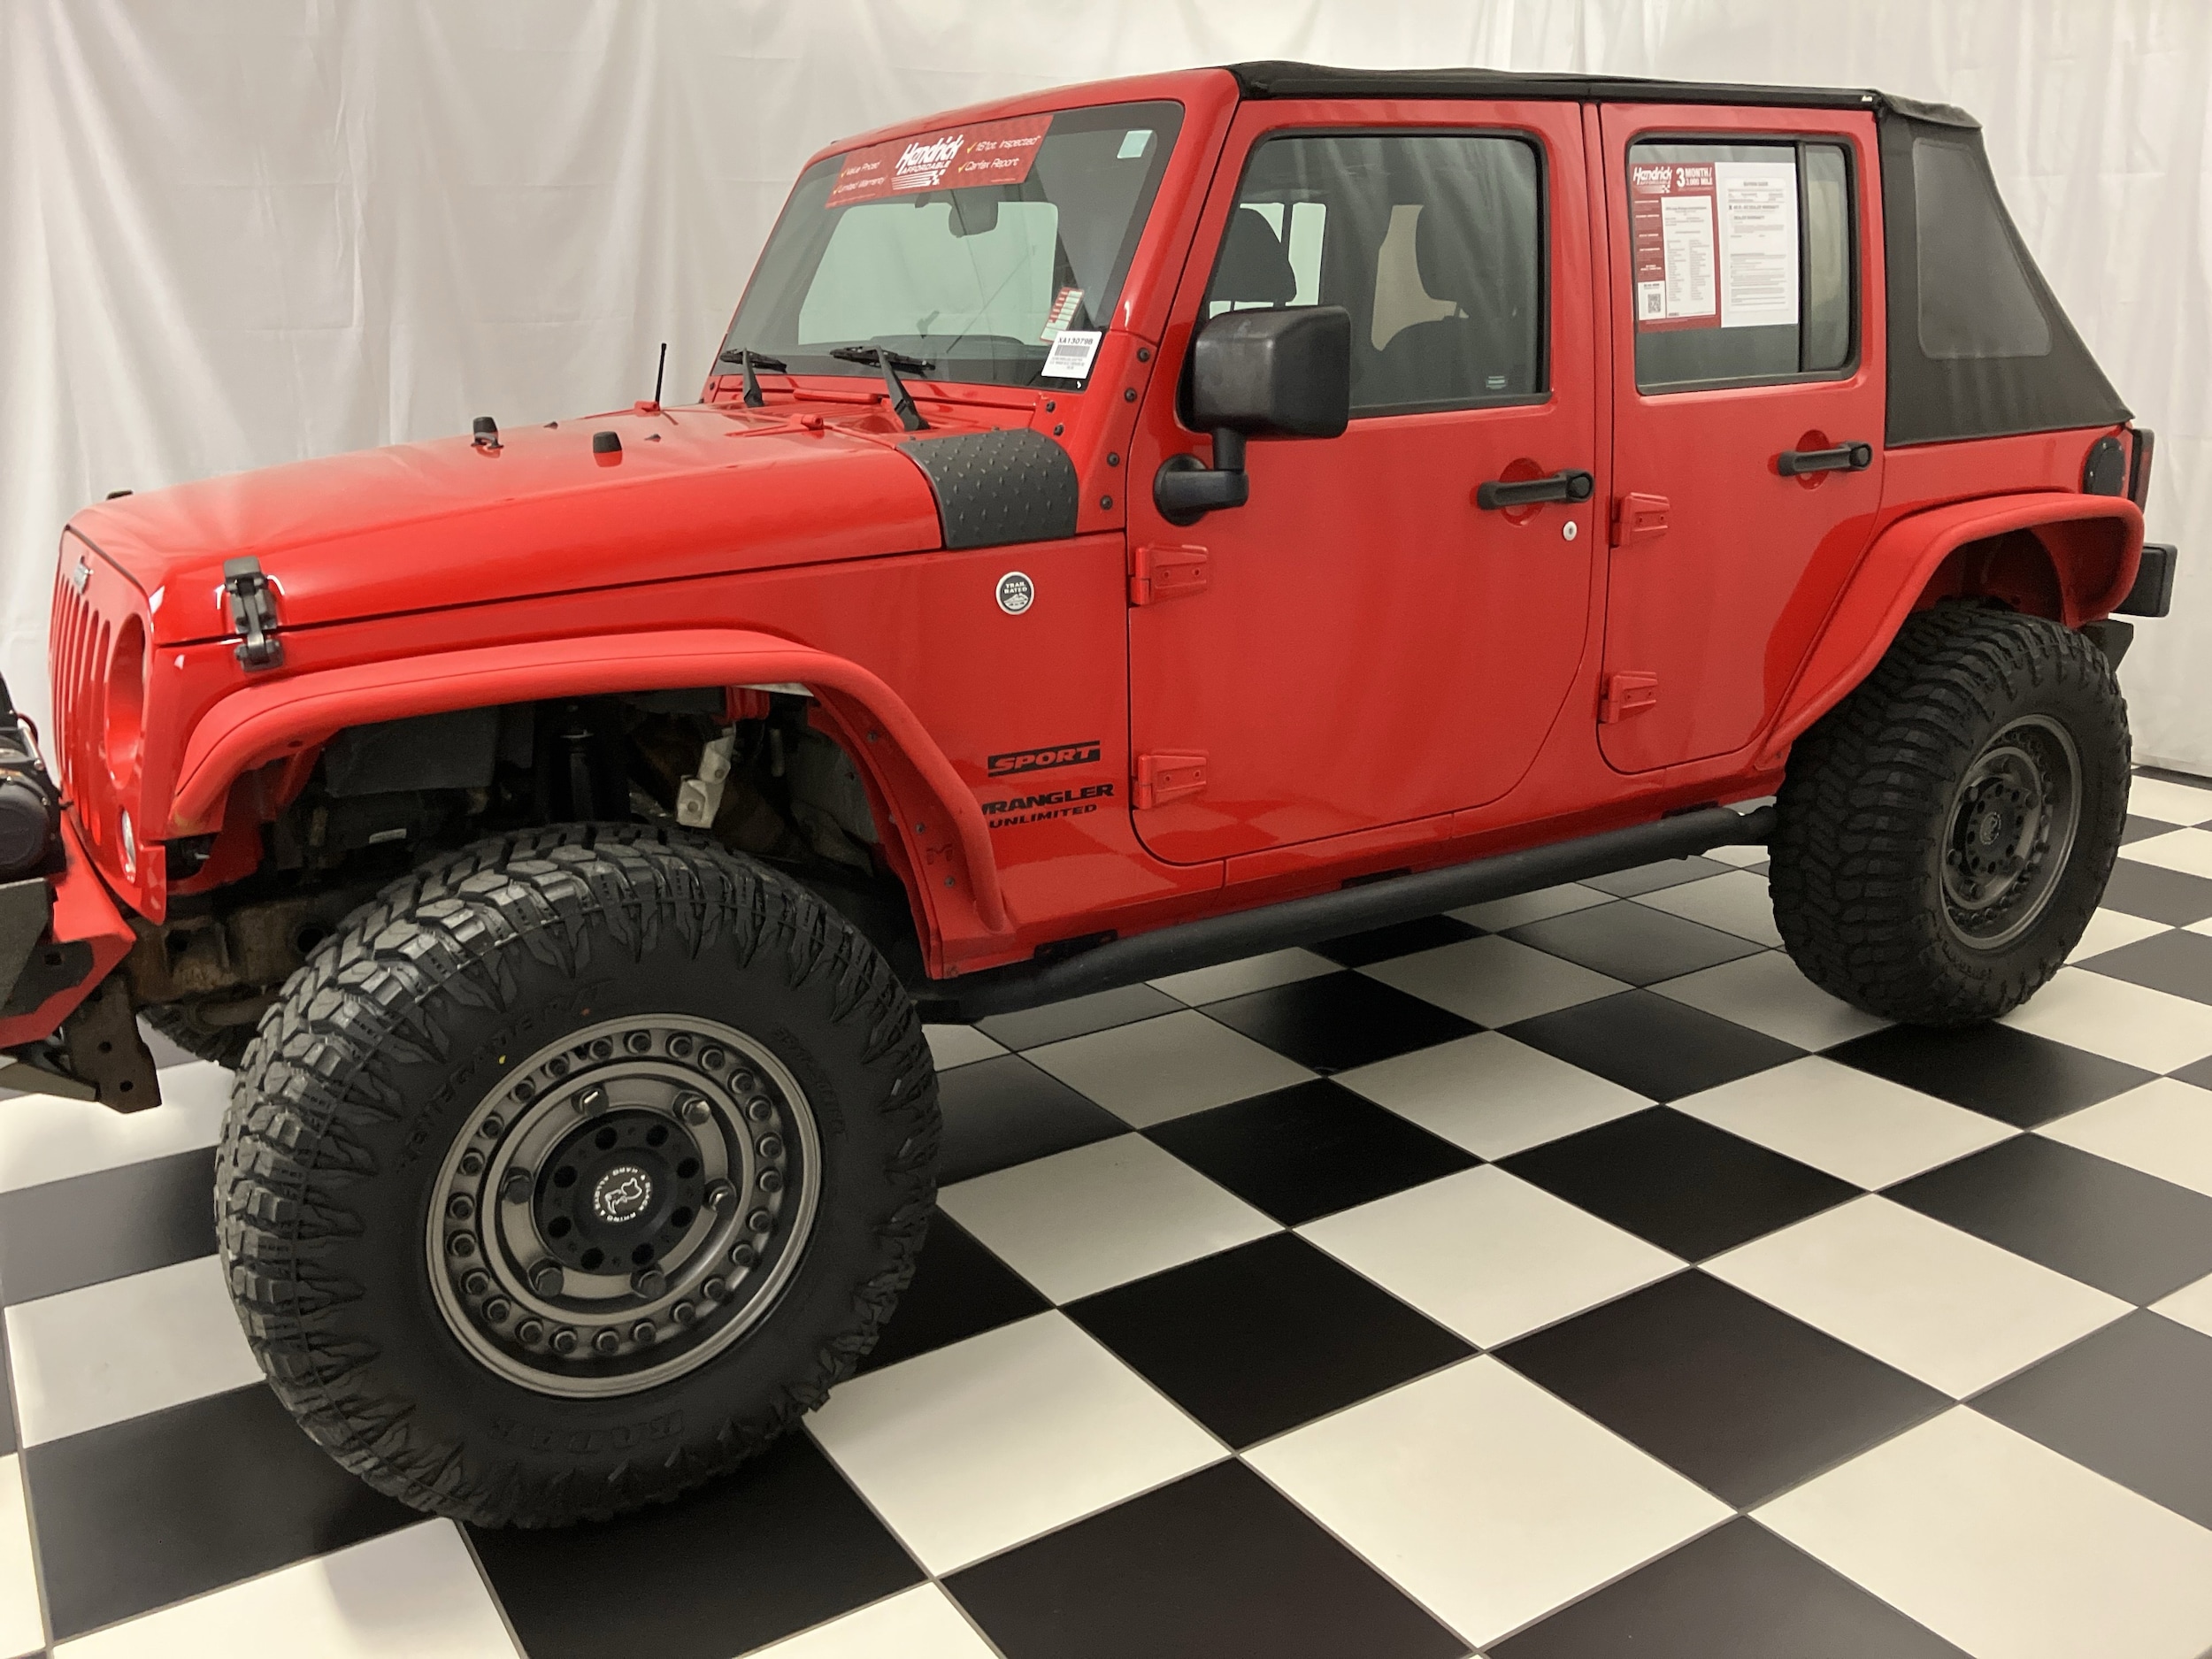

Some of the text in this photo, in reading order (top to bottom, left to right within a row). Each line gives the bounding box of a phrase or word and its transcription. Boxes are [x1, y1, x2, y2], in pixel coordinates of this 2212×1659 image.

[895, 134, 964, 175] Hendrick
[991, 157, 1019, 169] Report
[901, 159, 952, 174] AFFORDABLE
[1632, 165, 1672, 186] Hendrick
[1676, 167, 1686, 188] 3
[989, 743, 1100, 774] SPORT
[988, 803, 1097, 829] UNLIMITED
